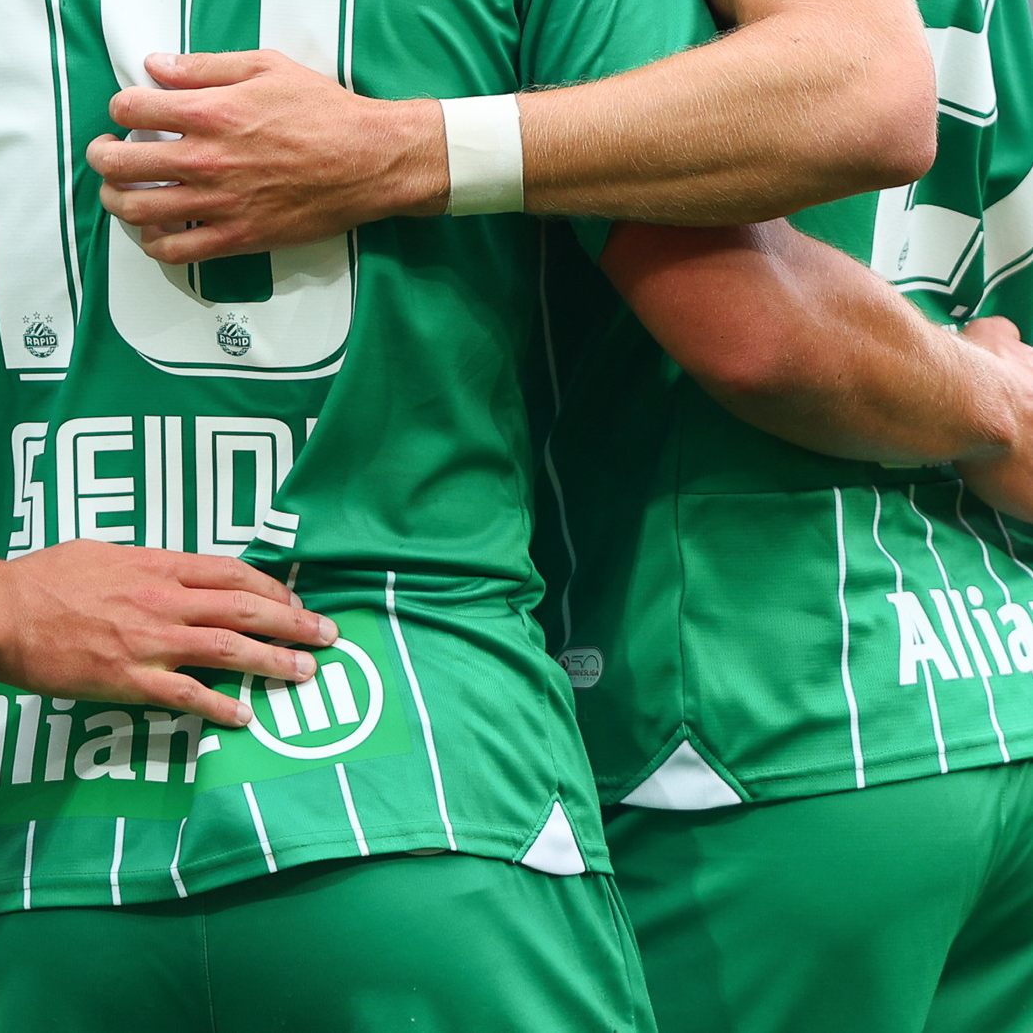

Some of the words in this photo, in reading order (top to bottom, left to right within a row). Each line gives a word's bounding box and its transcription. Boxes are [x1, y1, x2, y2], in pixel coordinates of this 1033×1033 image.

[24, 334, 58, 347] RAPID
[217, 334, 253, 348] RAPID
[885, 585, 1033, 686] Allia
